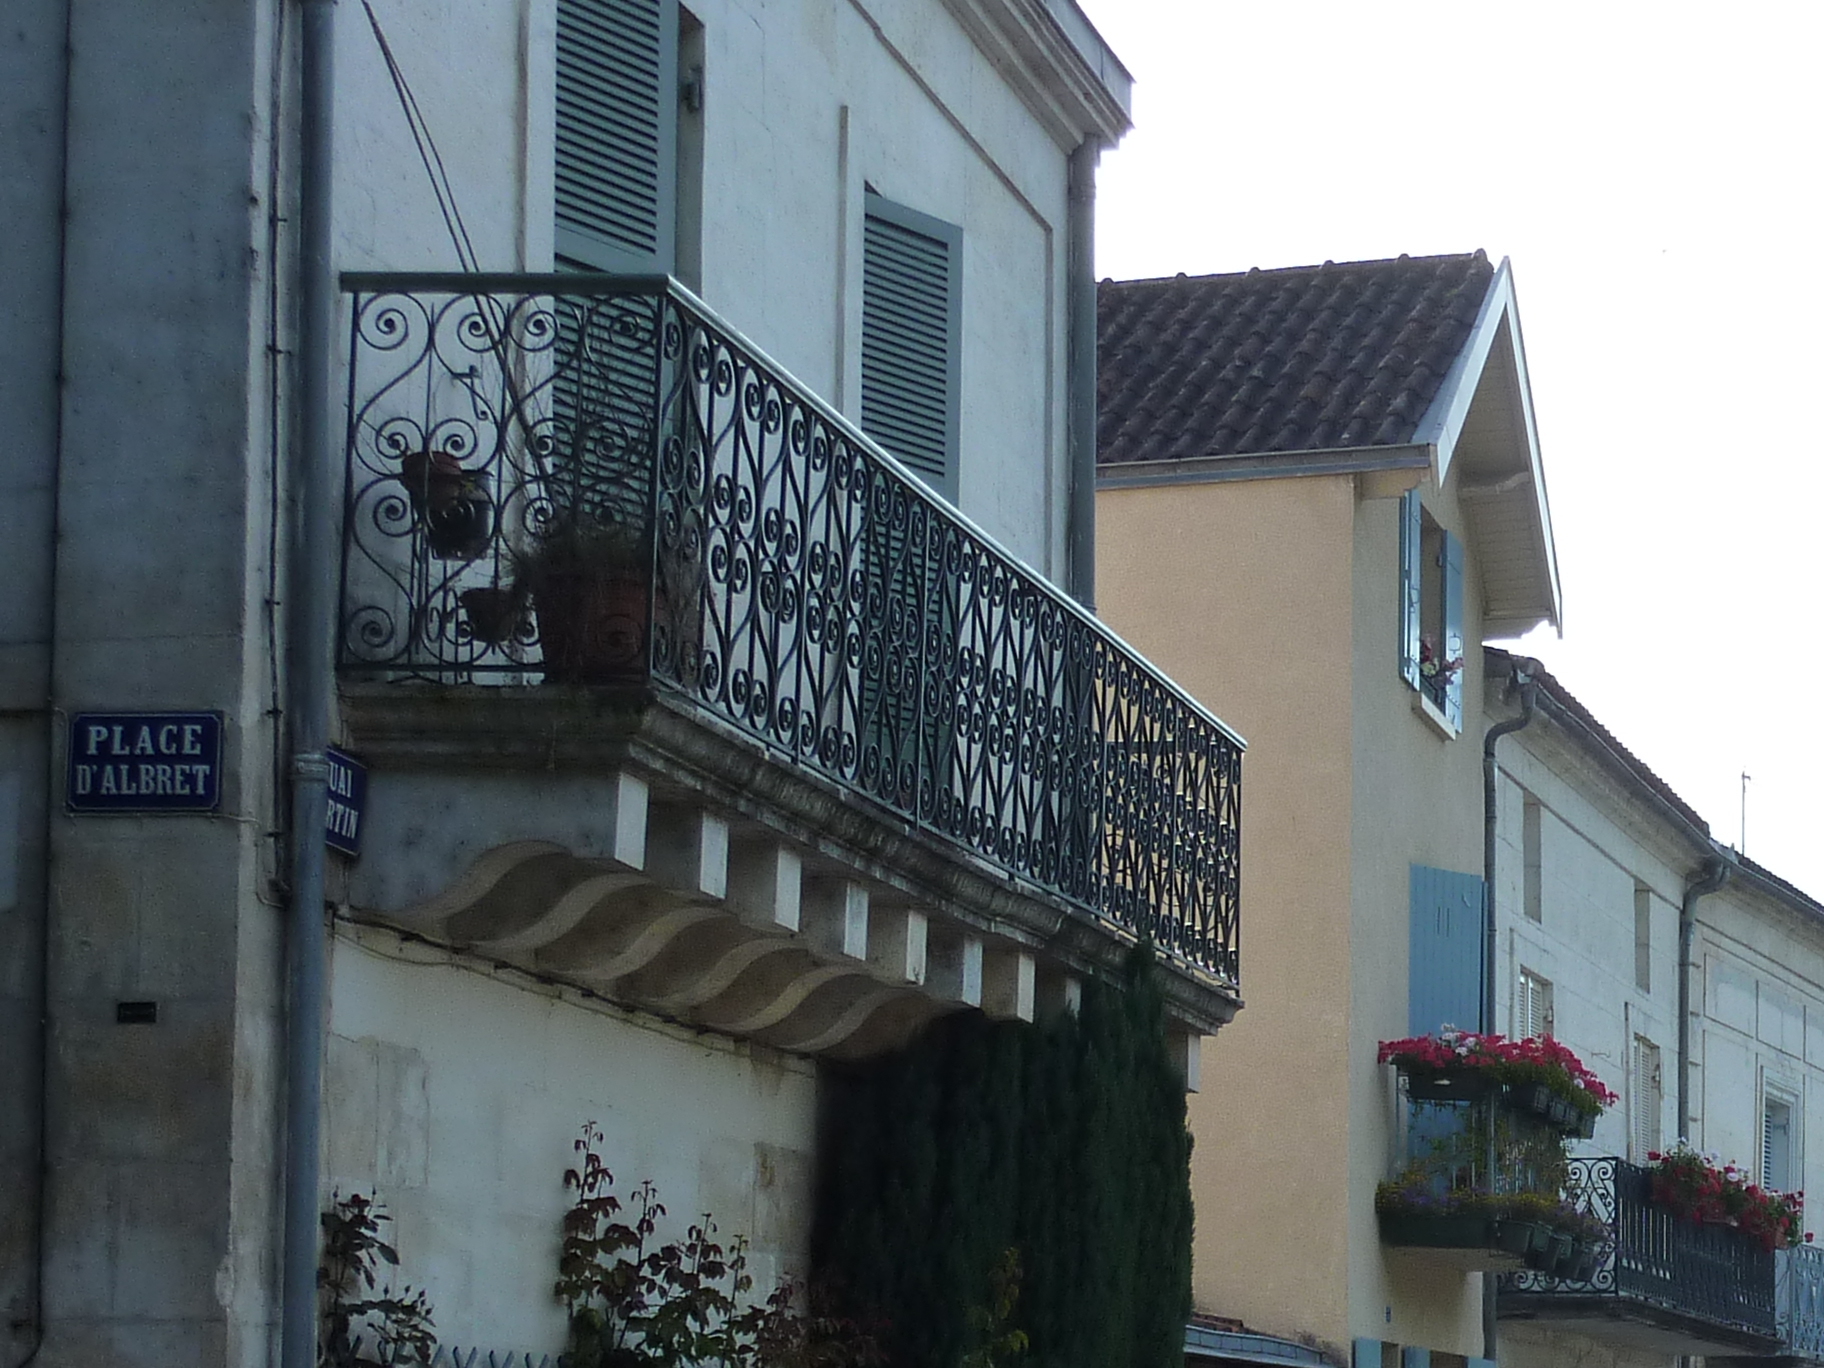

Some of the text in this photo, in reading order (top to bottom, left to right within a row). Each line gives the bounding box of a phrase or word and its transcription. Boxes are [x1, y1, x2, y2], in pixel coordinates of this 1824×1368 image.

[86, 724, 203, 756] PLACE
[75, 764, 211, 796] D'ALBRET
[328, 761, 353, 798] UAI
[325, 797, 360, 840] RTIN
